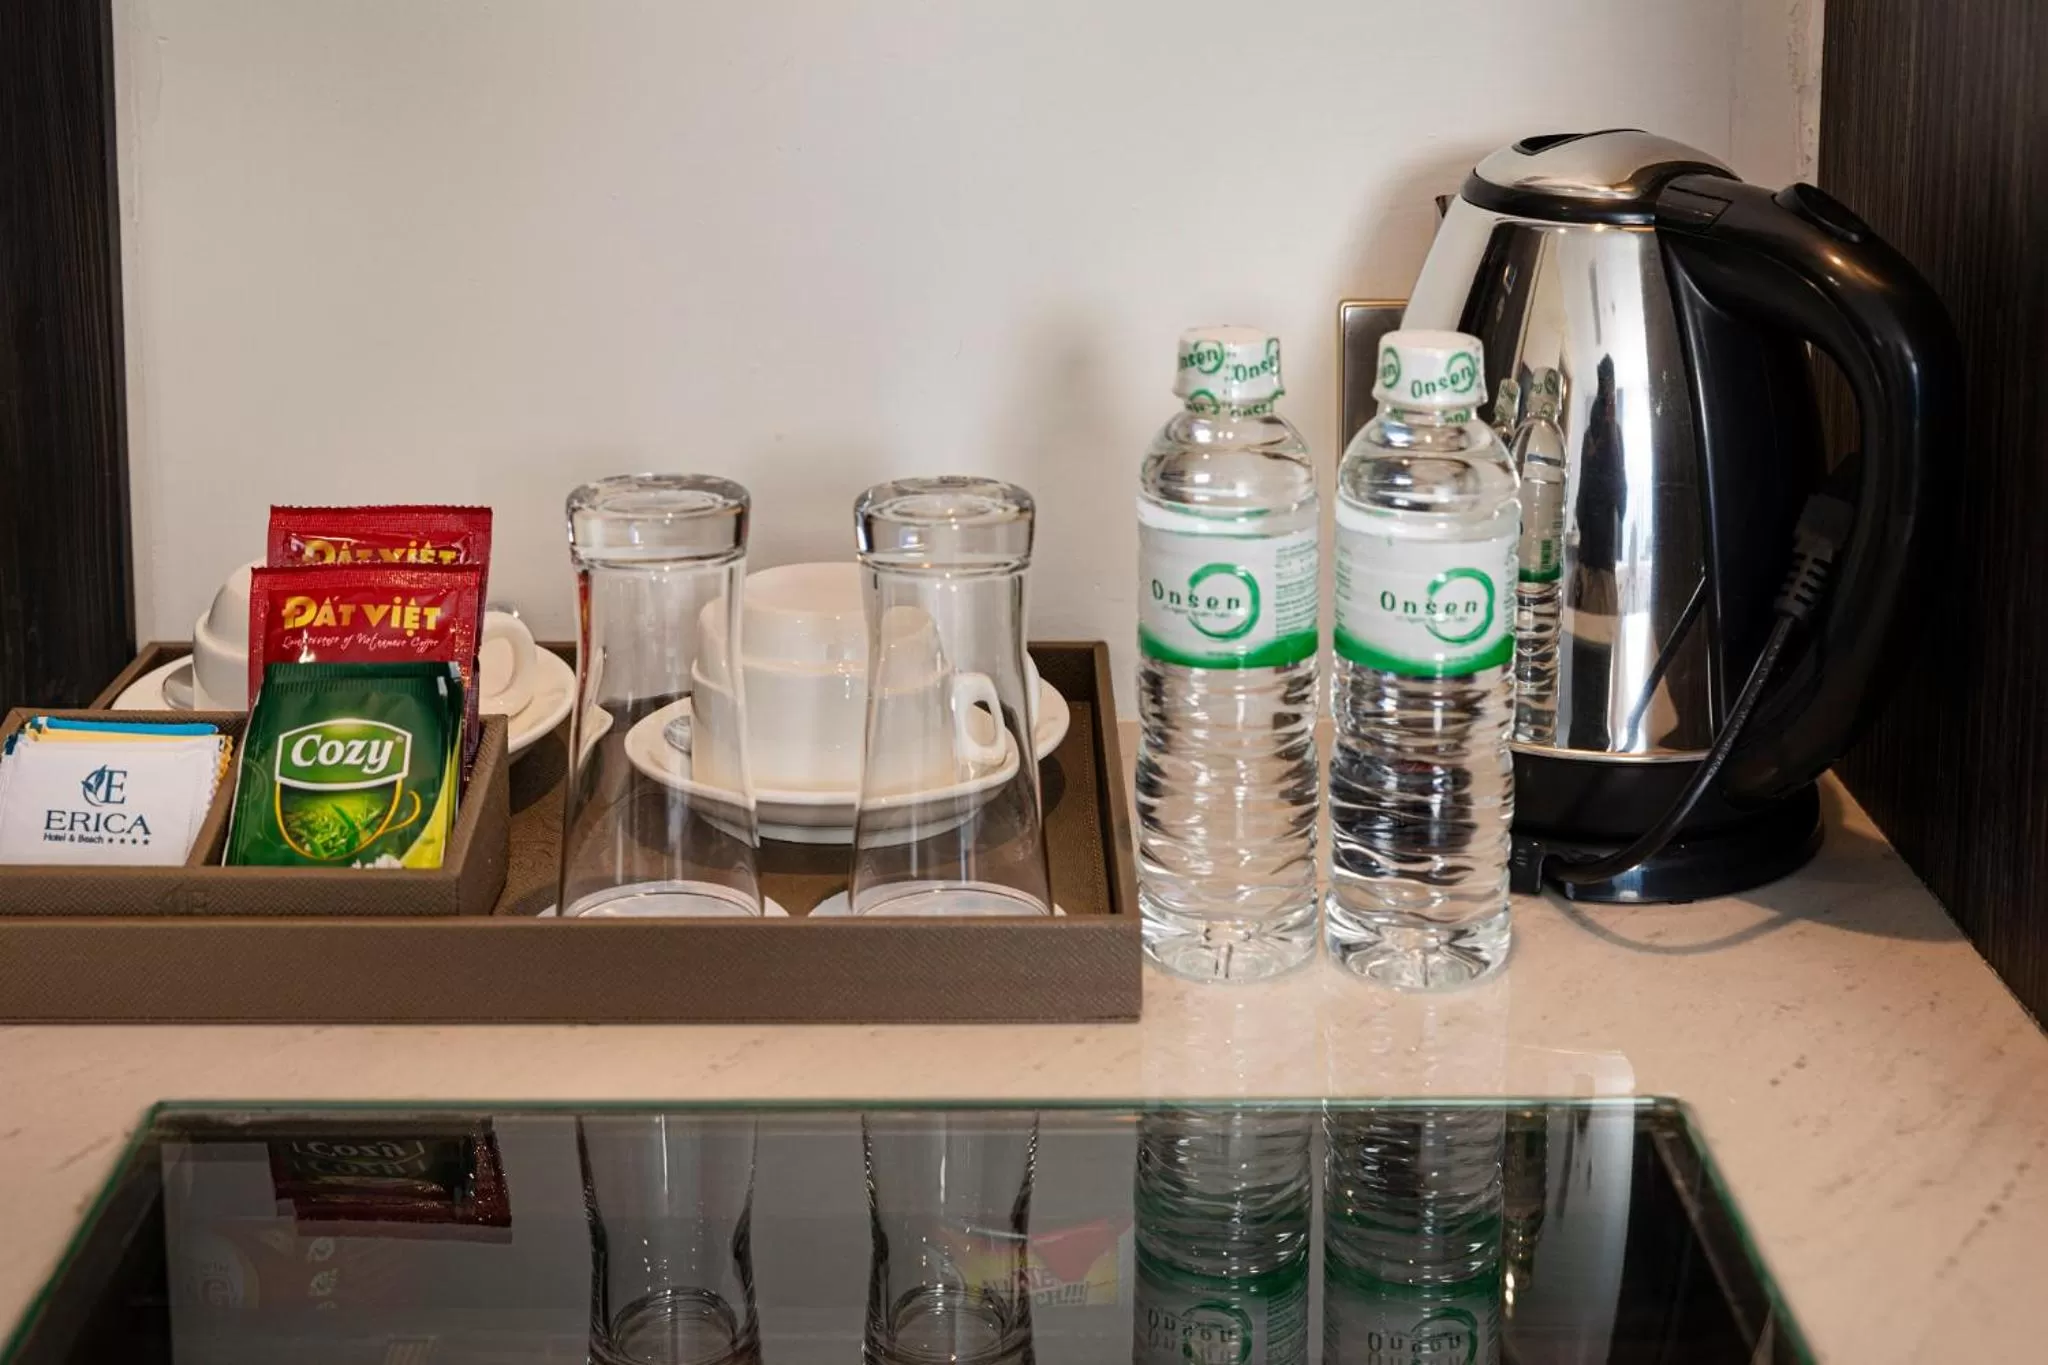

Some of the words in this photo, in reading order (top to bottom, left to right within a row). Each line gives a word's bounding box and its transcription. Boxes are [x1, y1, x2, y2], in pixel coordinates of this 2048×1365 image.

[1411, 365, 1473, 399] Onsen
[1152, 579, 1240, 611] Onsen
[1380, 590, 1478, 616] Onsen
[281, 595, 355, 631] ĐẤT
[291, 734, 394, 774] Cozy
[44, 809, 151, 835] ERICA
[43, 832, 66, 842] Hotel
[68, 833, 76, 843] &
[78, 834, 104, 845] Beach
